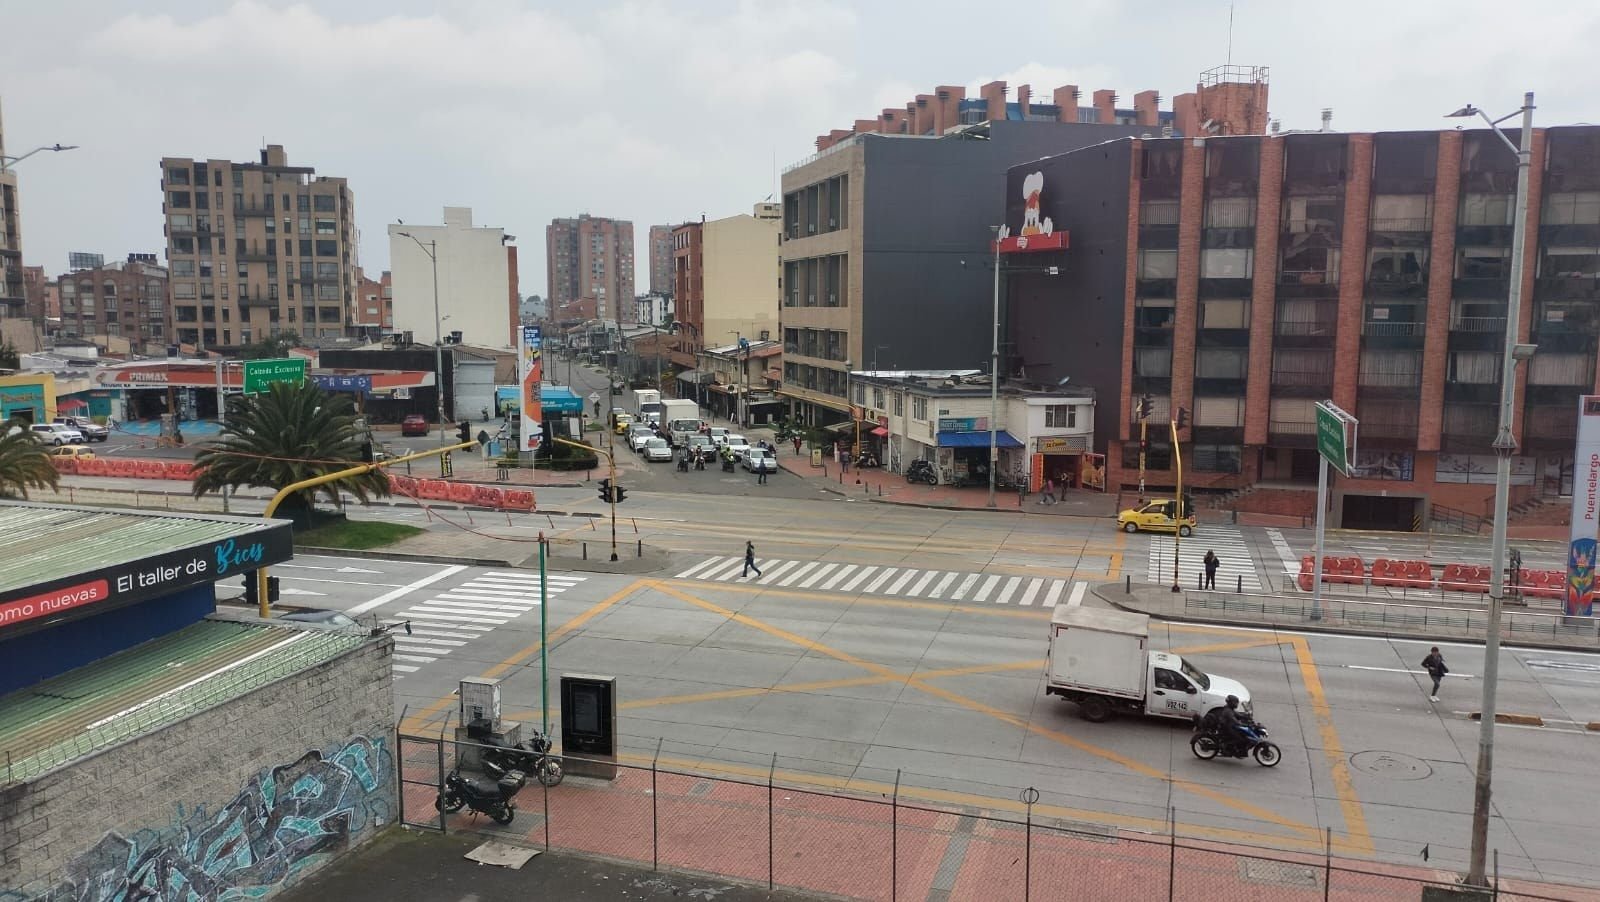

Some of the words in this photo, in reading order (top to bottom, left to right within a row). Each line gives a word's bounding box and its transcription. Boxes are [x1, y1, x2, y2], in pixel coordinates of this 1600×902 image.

[128, 372, 169, 382] PRIMAX
[1584, 453, 1600, 521] Puentelargo
[117, 574, 133, 593] El
[138, 565, 182, 587] taller
[186, 558, 207, 575] de
[40, 588, 97, 611] nuevas
